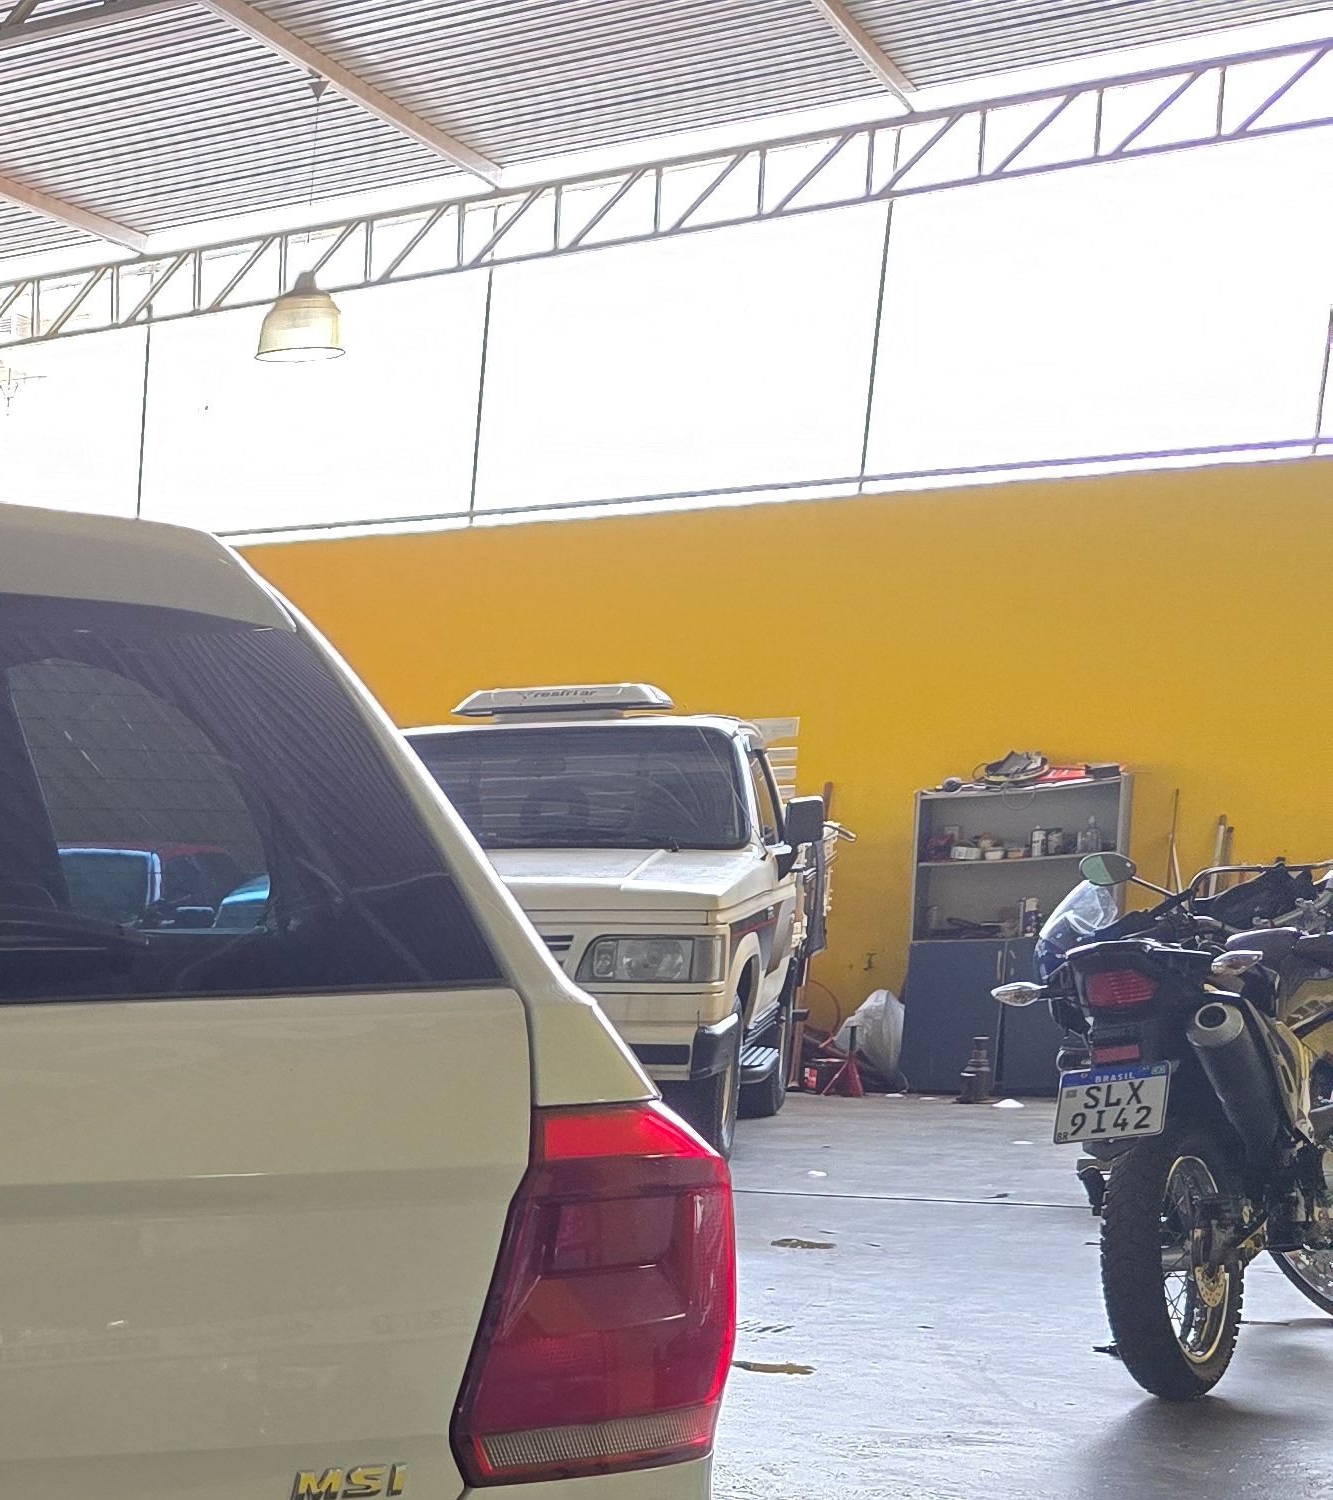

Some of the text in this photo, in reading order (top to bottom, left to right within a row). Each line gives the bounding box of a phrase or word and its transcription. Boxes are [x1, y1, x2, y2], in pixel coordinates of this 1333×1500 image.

[1095, 1072, 1135, 1083] BRASIL
[1083, 1080, 1144, 1109] SLX
[1070, 1105, 1152, 1135] 9I42
